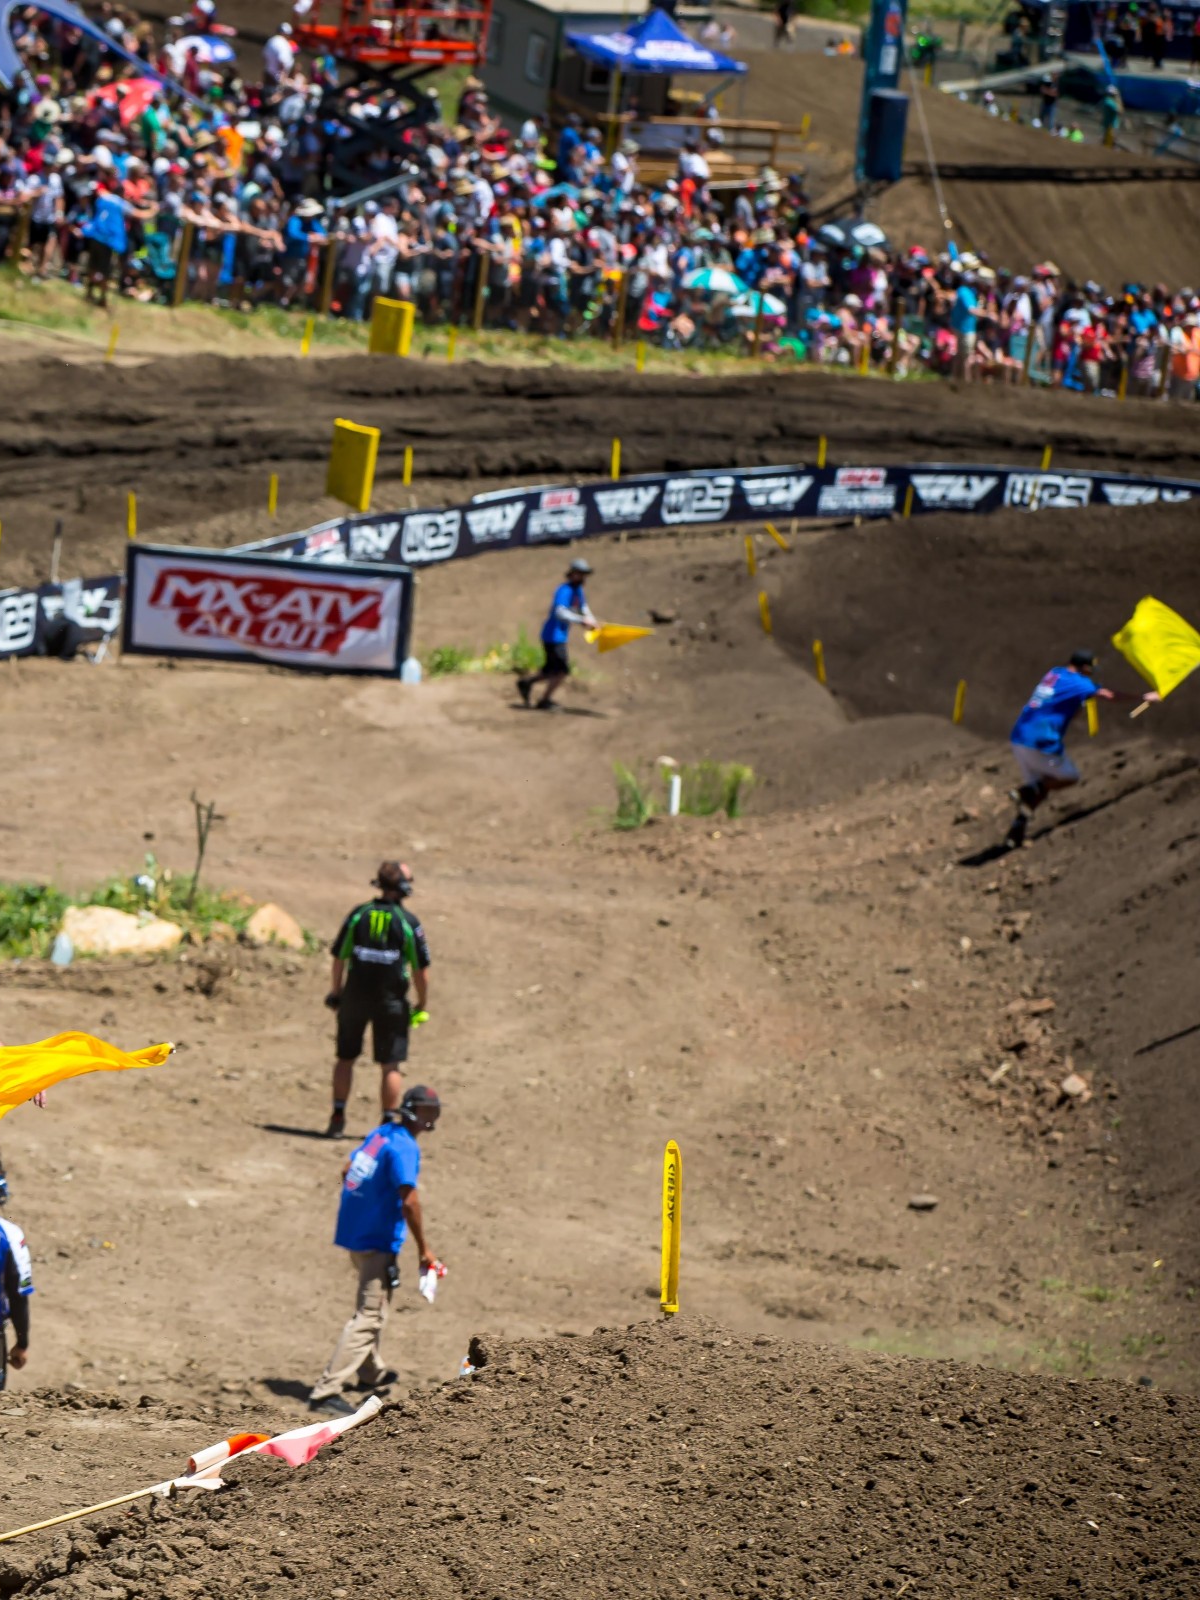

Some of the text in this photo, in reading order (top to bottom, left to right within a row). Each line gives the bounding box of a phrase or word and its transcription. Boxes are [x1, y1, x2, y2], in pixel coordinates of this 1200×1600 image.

[910, 474, 1000, 503] FLY
[258, 588, 381, 623] ATV
[185, 614, 338, 649] ALL OUT
